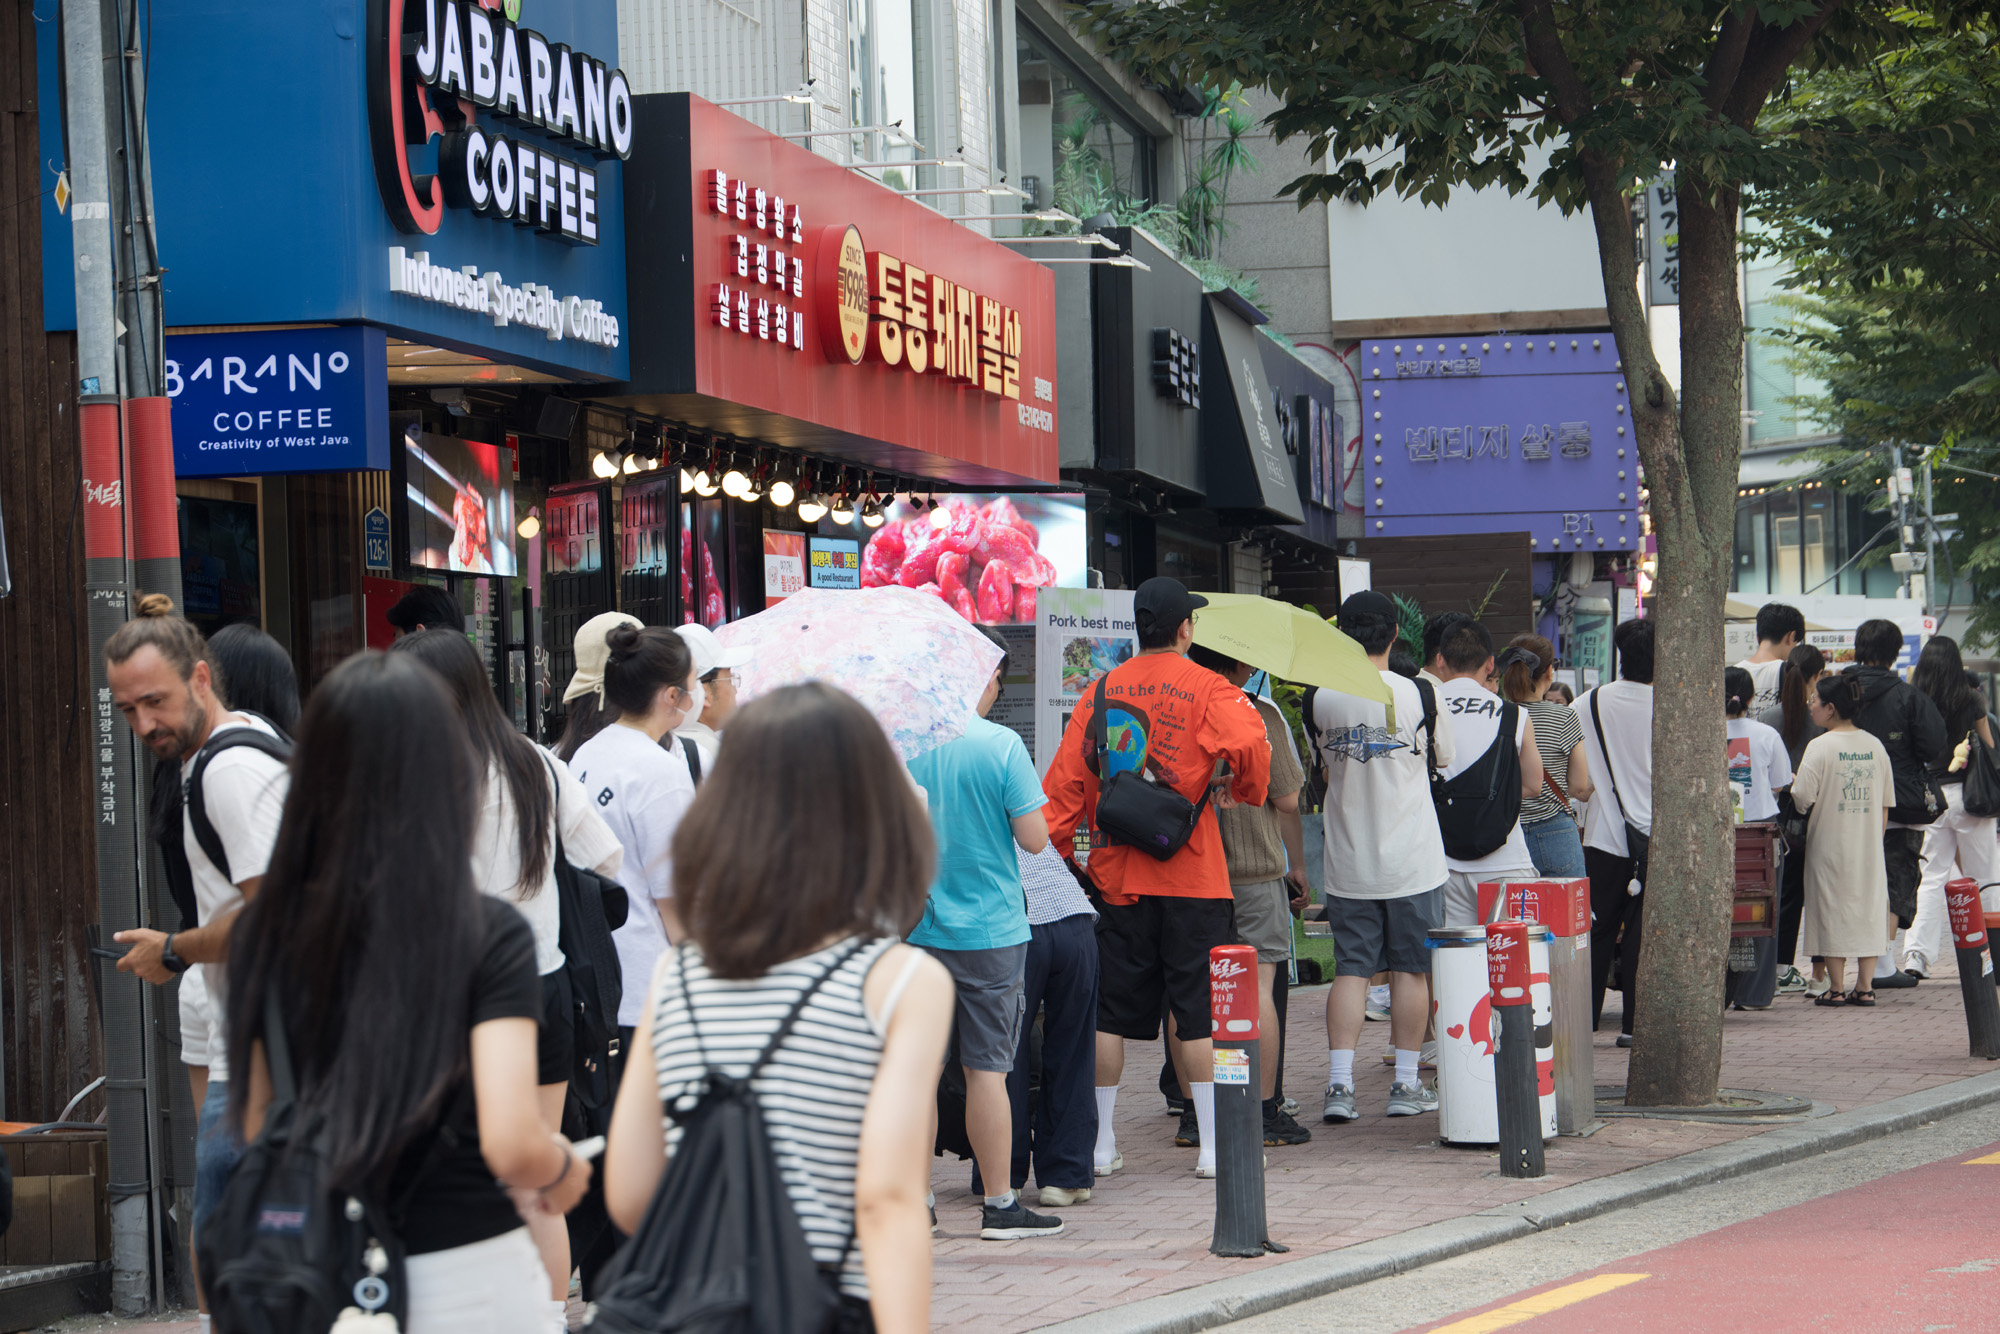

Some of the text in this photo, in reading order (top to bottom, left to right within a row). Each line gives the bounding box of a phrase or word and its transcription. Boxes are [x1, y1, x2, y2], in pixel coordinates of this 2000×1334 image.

[415, 0, 632, 154] JABARANO
[466, 131, 597, 240] COFFEE
[845, 244, 862, 267] SINCE
[388, 246, 620, 348] Indonesia Specialty Coffee
[839, 265, 865, 313] 1998
[1396, 360, 1437, 375] 빈티지
[213, 407, 333, 433] COFFEE
[199, 435, 349, 451] Creativity of West Java
[1405, 420, 1592, 462] 빈티지 살롱
[1562, 513, 1595, 534] B1
[368, 538, 389, 561] 126-1
[811, 549, 832, 569] 여행객
[831, 551, 845, 569] 추천
[844, 552, 858, 570] 맛집
[817, 572, 854, 584] A good Restaurant
[1049, 614, 1078, 628] Pork
[1081, 616, 1109, 630] best
[1583, 636, 1597, 667] 빈티지
[1106, 685, 1125, 697] on
[1128, 684, 1156, 697] the
[1160, 682, 1195, 703] Moon
[97, 687, 116, 826] 불법광고물 부착금지
[1838, 751, 1873, 761] Mutual
